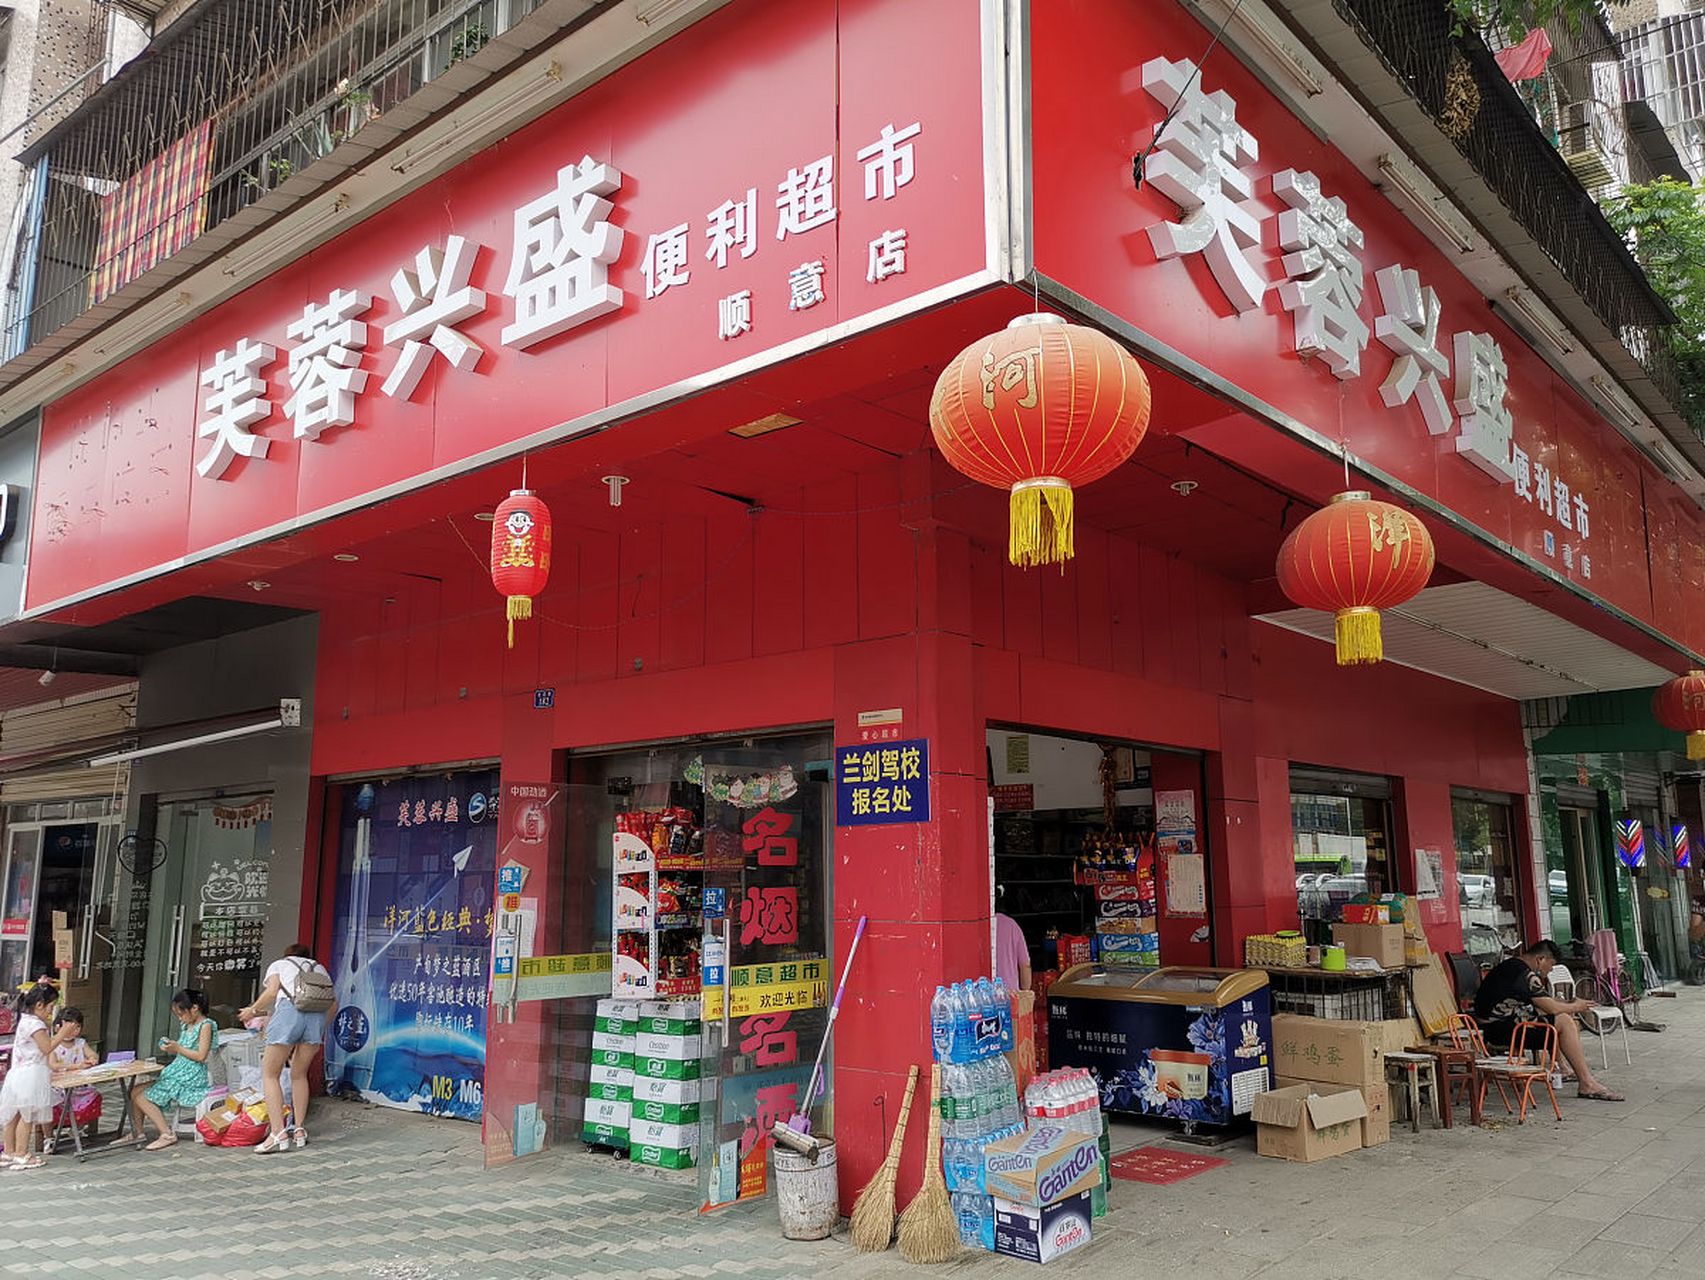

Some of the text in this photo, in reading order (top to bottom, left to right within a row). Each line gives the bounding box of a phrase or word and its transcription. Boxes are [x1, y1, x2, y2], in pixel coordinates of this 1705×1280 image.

[718, 228, 909, 340] 顺意店
[1141, 55, 1514, 484] 芙蓉兴盛
[196, 121, 922, 479] 芙蓉兴盛 便利超市
[1513, 442, 1590, 540] 便利超市
[843, 746, 921, 783] 兰剑驾校
[852, 785, 912, 815] 报名处
[731, 963, 820, 986] 顺意超市
[760, 988, 808, 1008] 欢迎光临
[1281, 1040, 1345, 1068] 鲜鸡蛋
[432, 1075, 482, 1105] M3 M6
